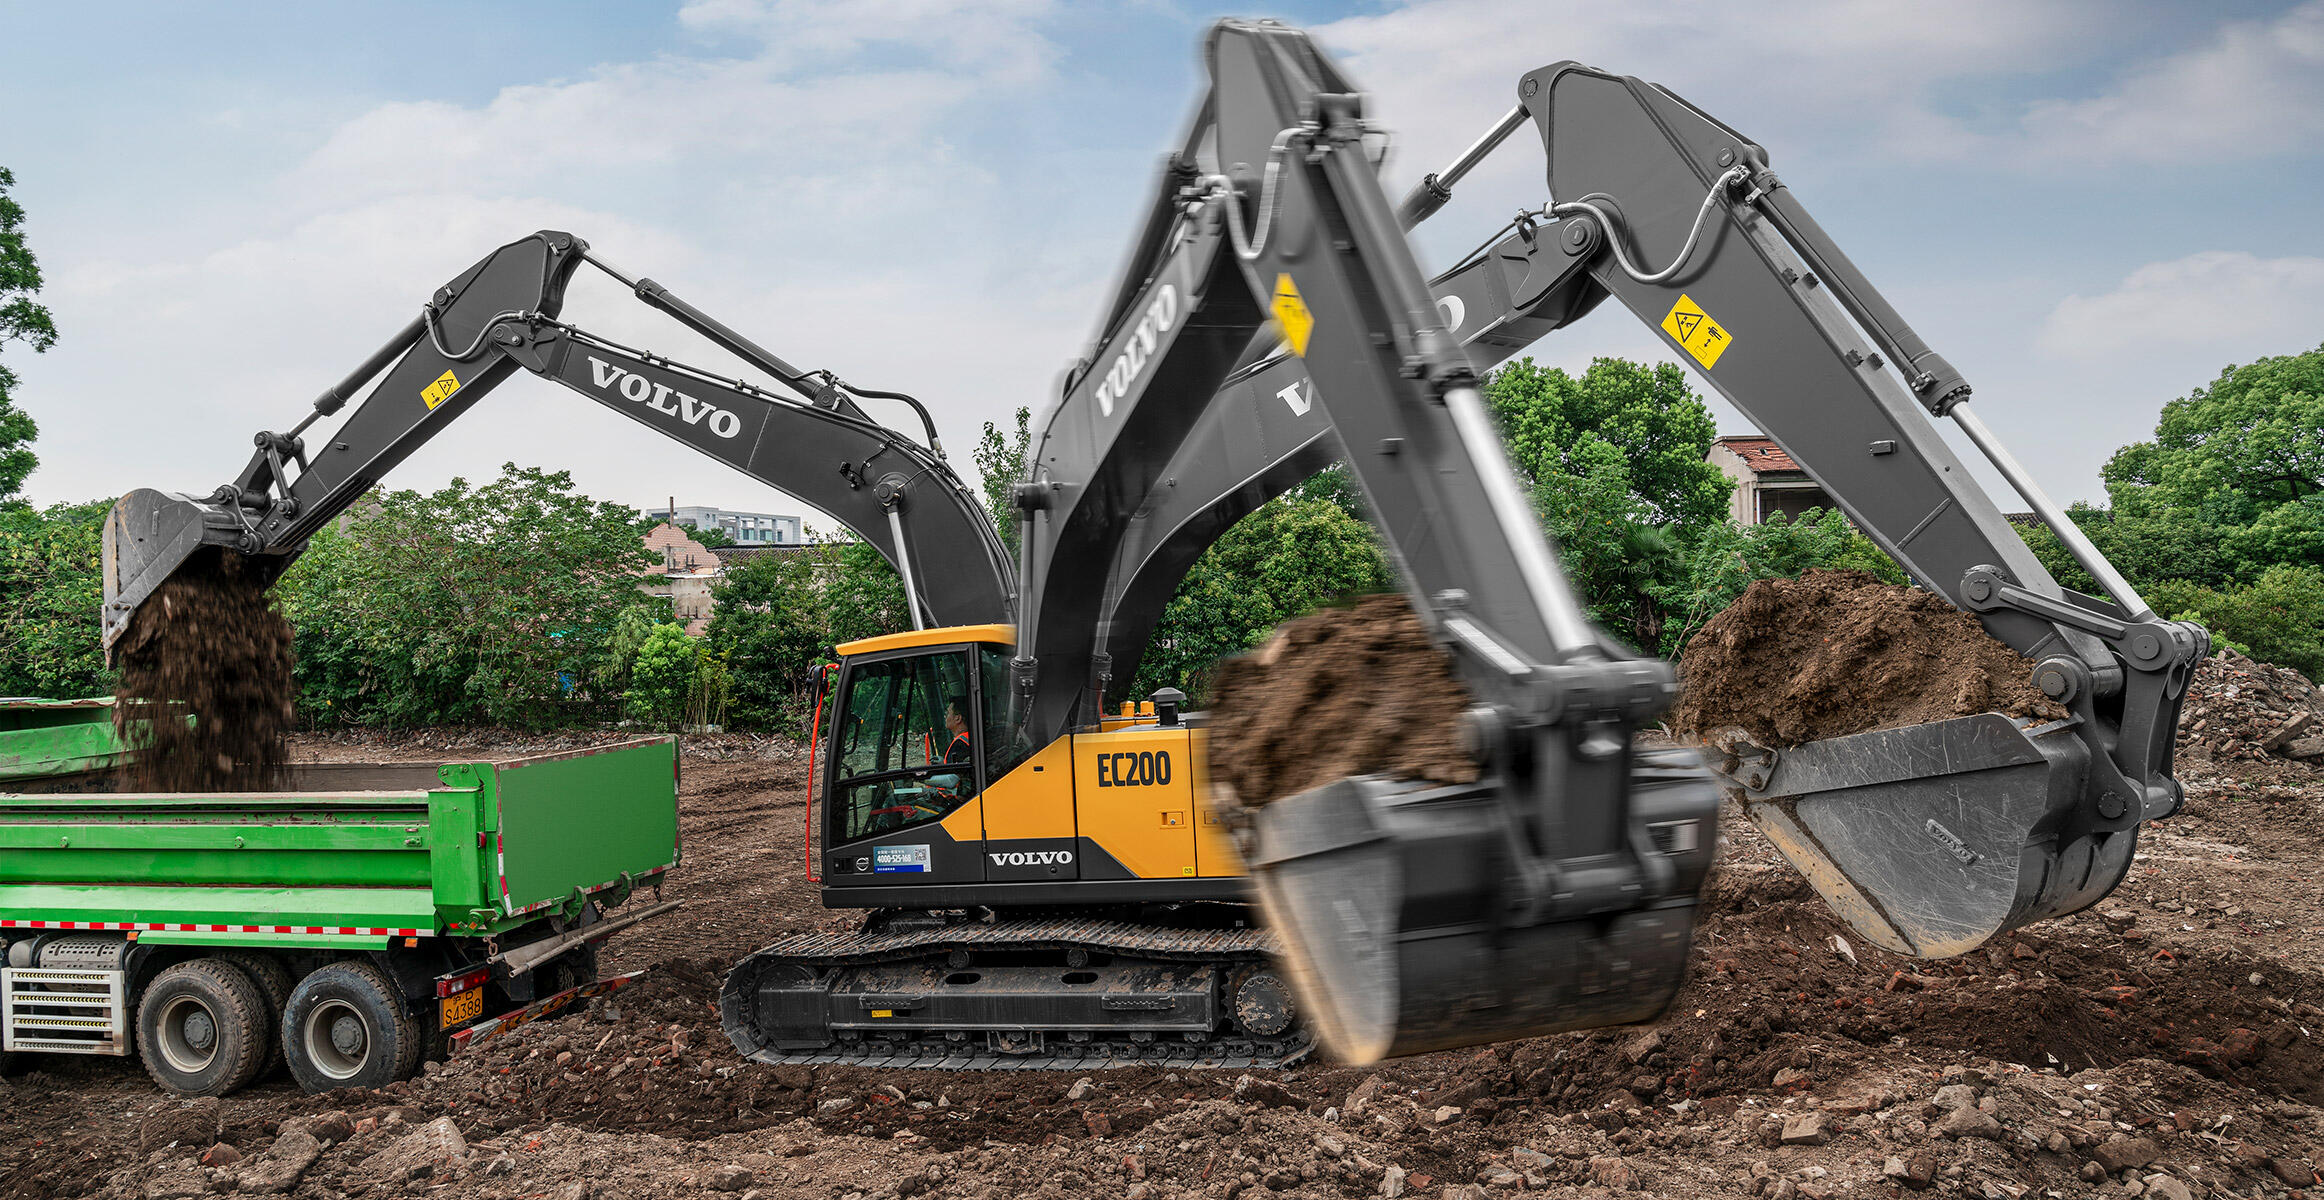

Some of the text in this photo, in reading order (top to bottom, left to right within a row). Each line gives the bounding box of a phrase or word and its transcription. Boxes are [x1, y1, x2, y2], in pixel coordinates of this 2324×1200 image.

[1095, 284, 1177, 417] VOLVO
[588, 356, 741, 439] VOLVO
[1097, 751, 1171, 787] EC200
[989, 850, 1073, 866] VOLVO
[445, 998, 481, 1024] S4388
